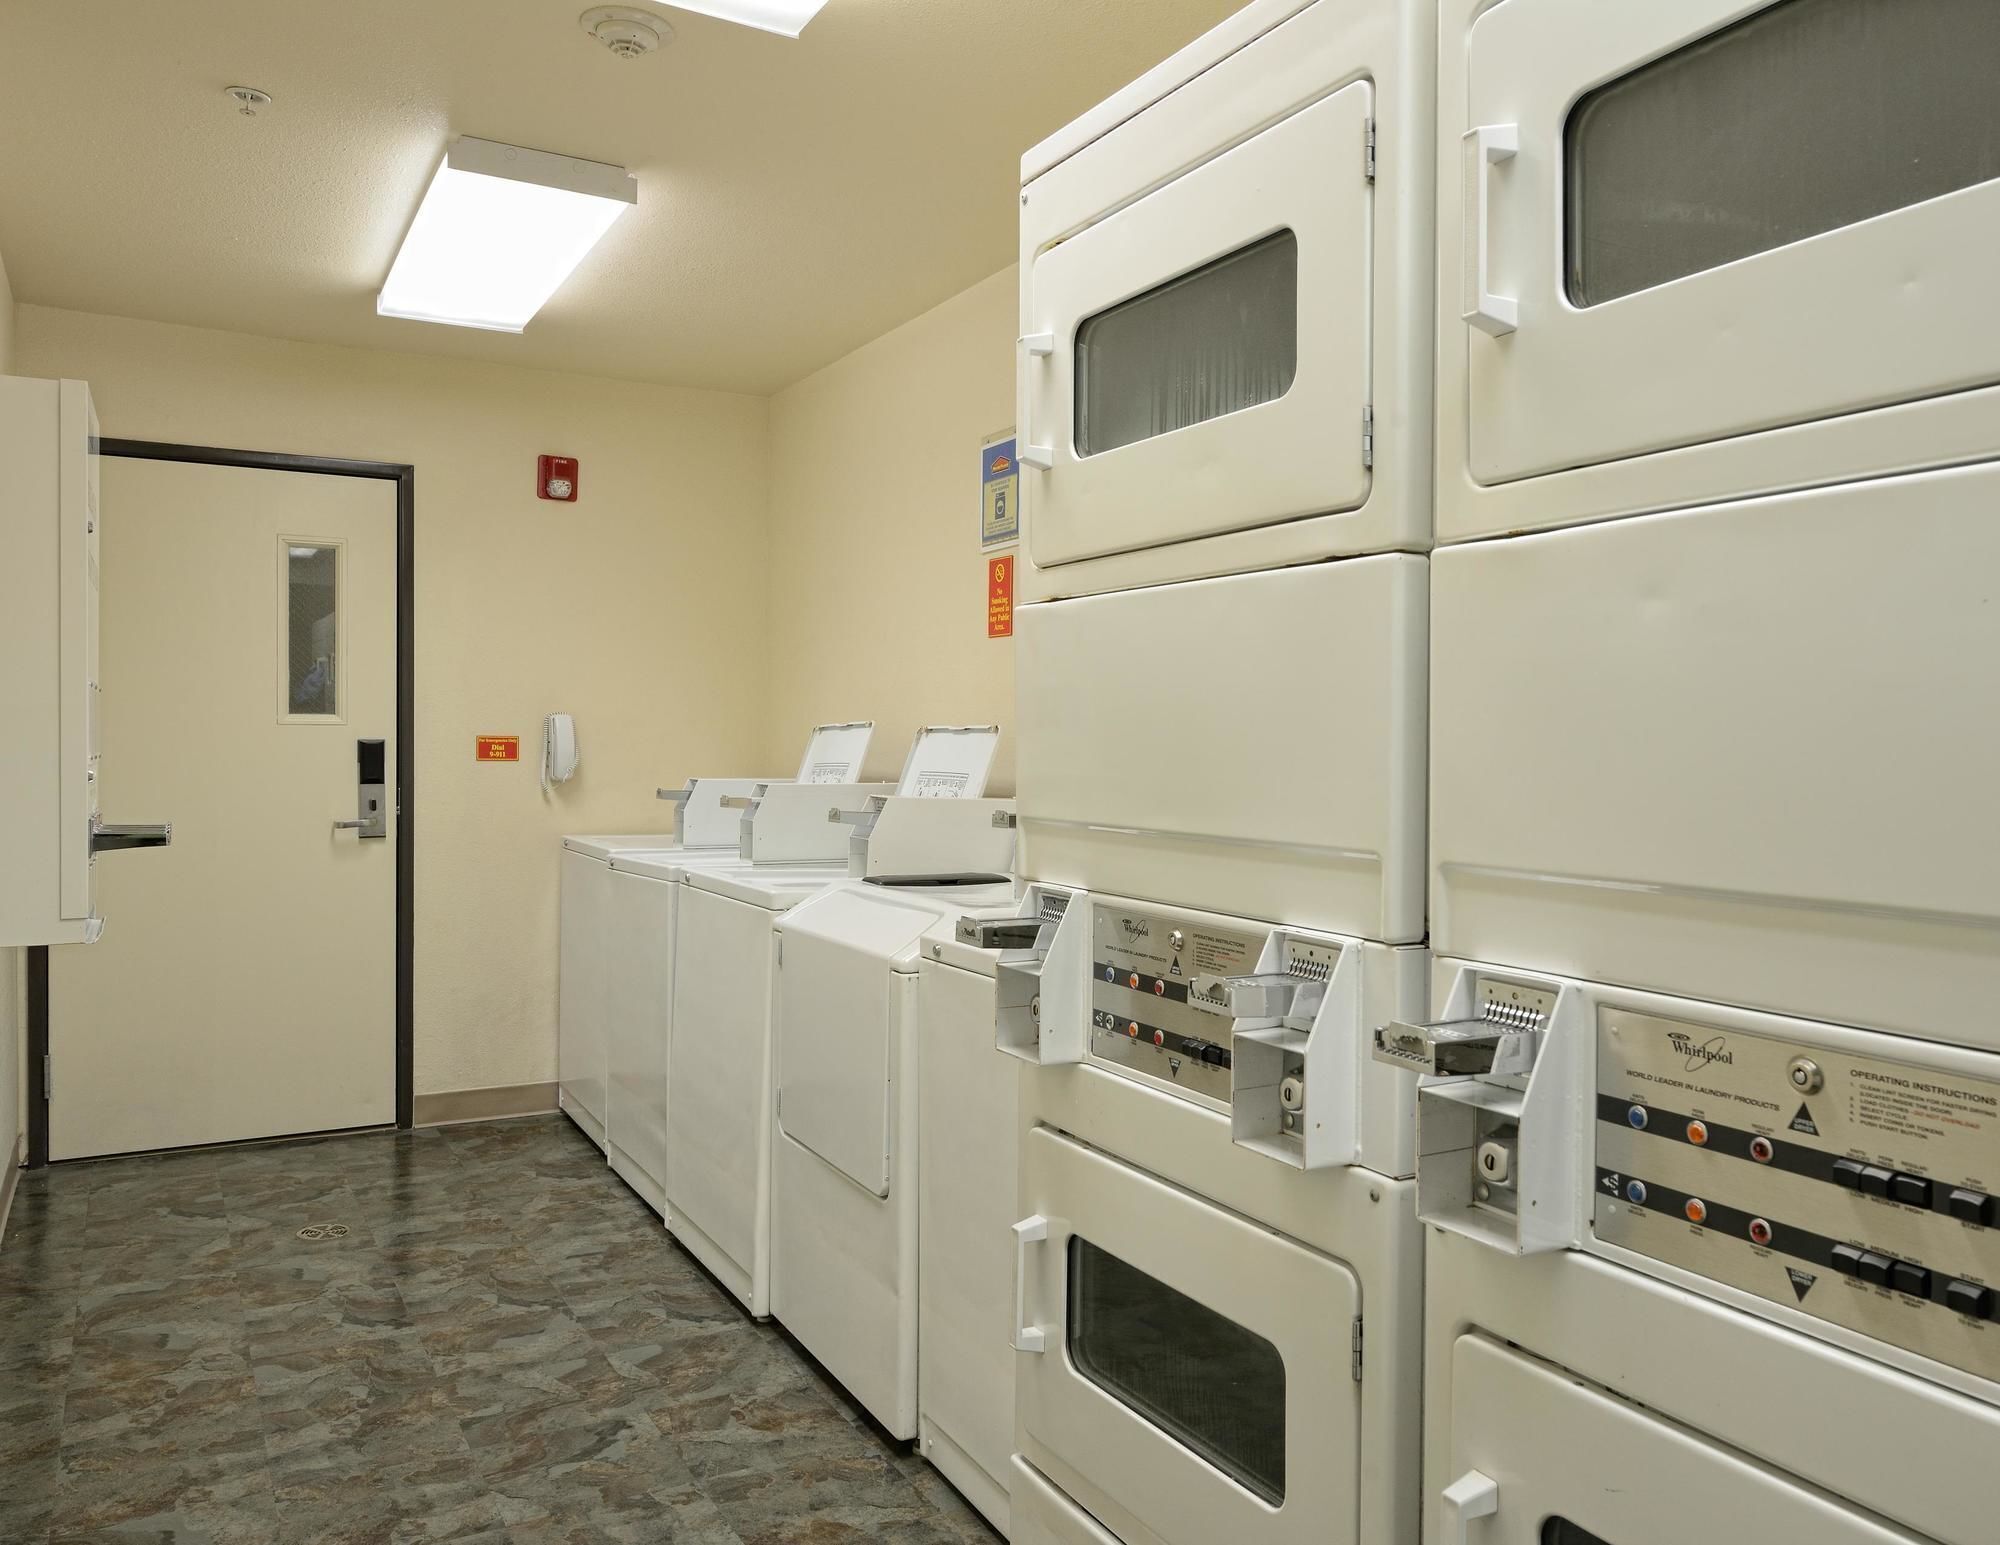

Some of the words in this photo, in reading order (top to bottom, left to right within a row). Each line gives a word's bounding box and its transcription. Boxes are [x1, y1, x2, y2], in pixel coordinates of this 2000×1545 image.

[1672, 1039, 1732, 1065] Whirlpool
[1626, 1069, 1654, 1082] WORLD
[1654, 1075, 1684, 1088] LEADER
[1685, 1083, 1694, 1091] IN
[1694, 1086, 1733, 1100] LAUNDRY
[1734, 1094, 1781, 1112] PRODUCTS
[1850, 1069, 1910, 1088] OPERATING
[1912, 1082, 1998, 1106] INSTRUCTIONS
